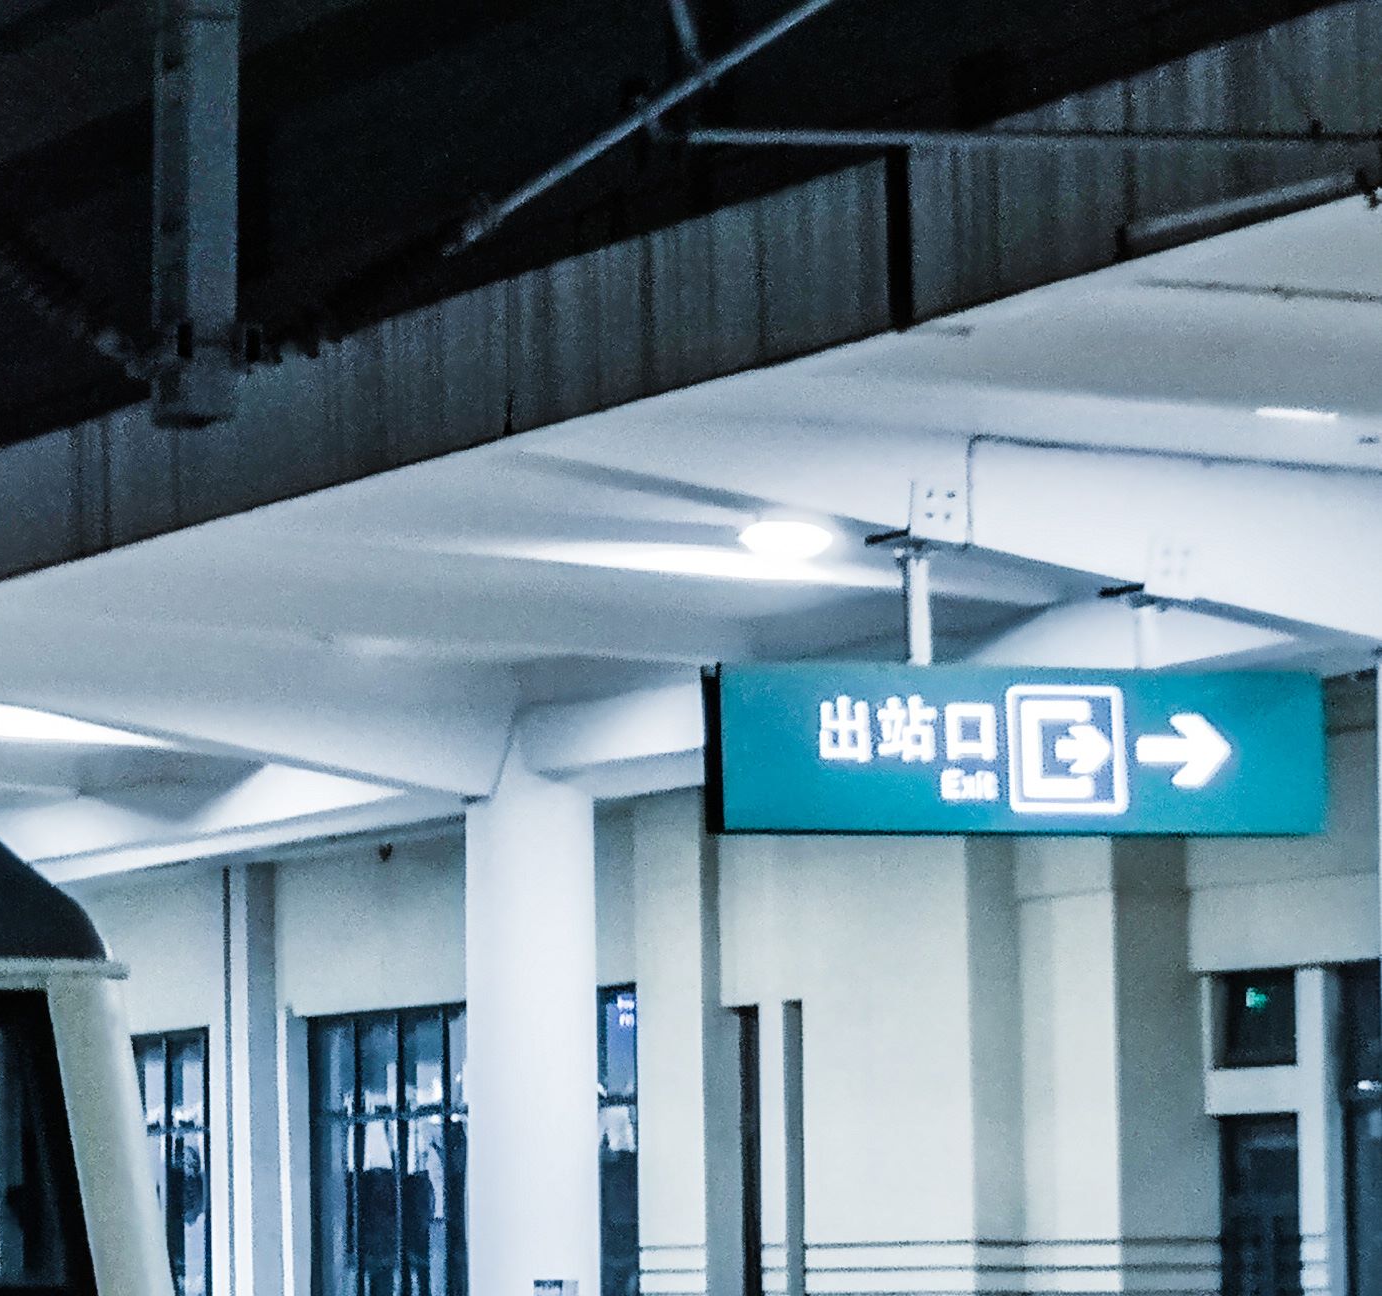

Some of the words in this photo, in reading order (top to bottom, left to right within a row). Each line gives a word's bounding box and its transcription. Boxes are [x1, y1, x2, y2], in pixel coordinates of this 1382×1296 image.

[819, 694, 998, 764] 出站口
[940, 769, 999, 800] Exit
